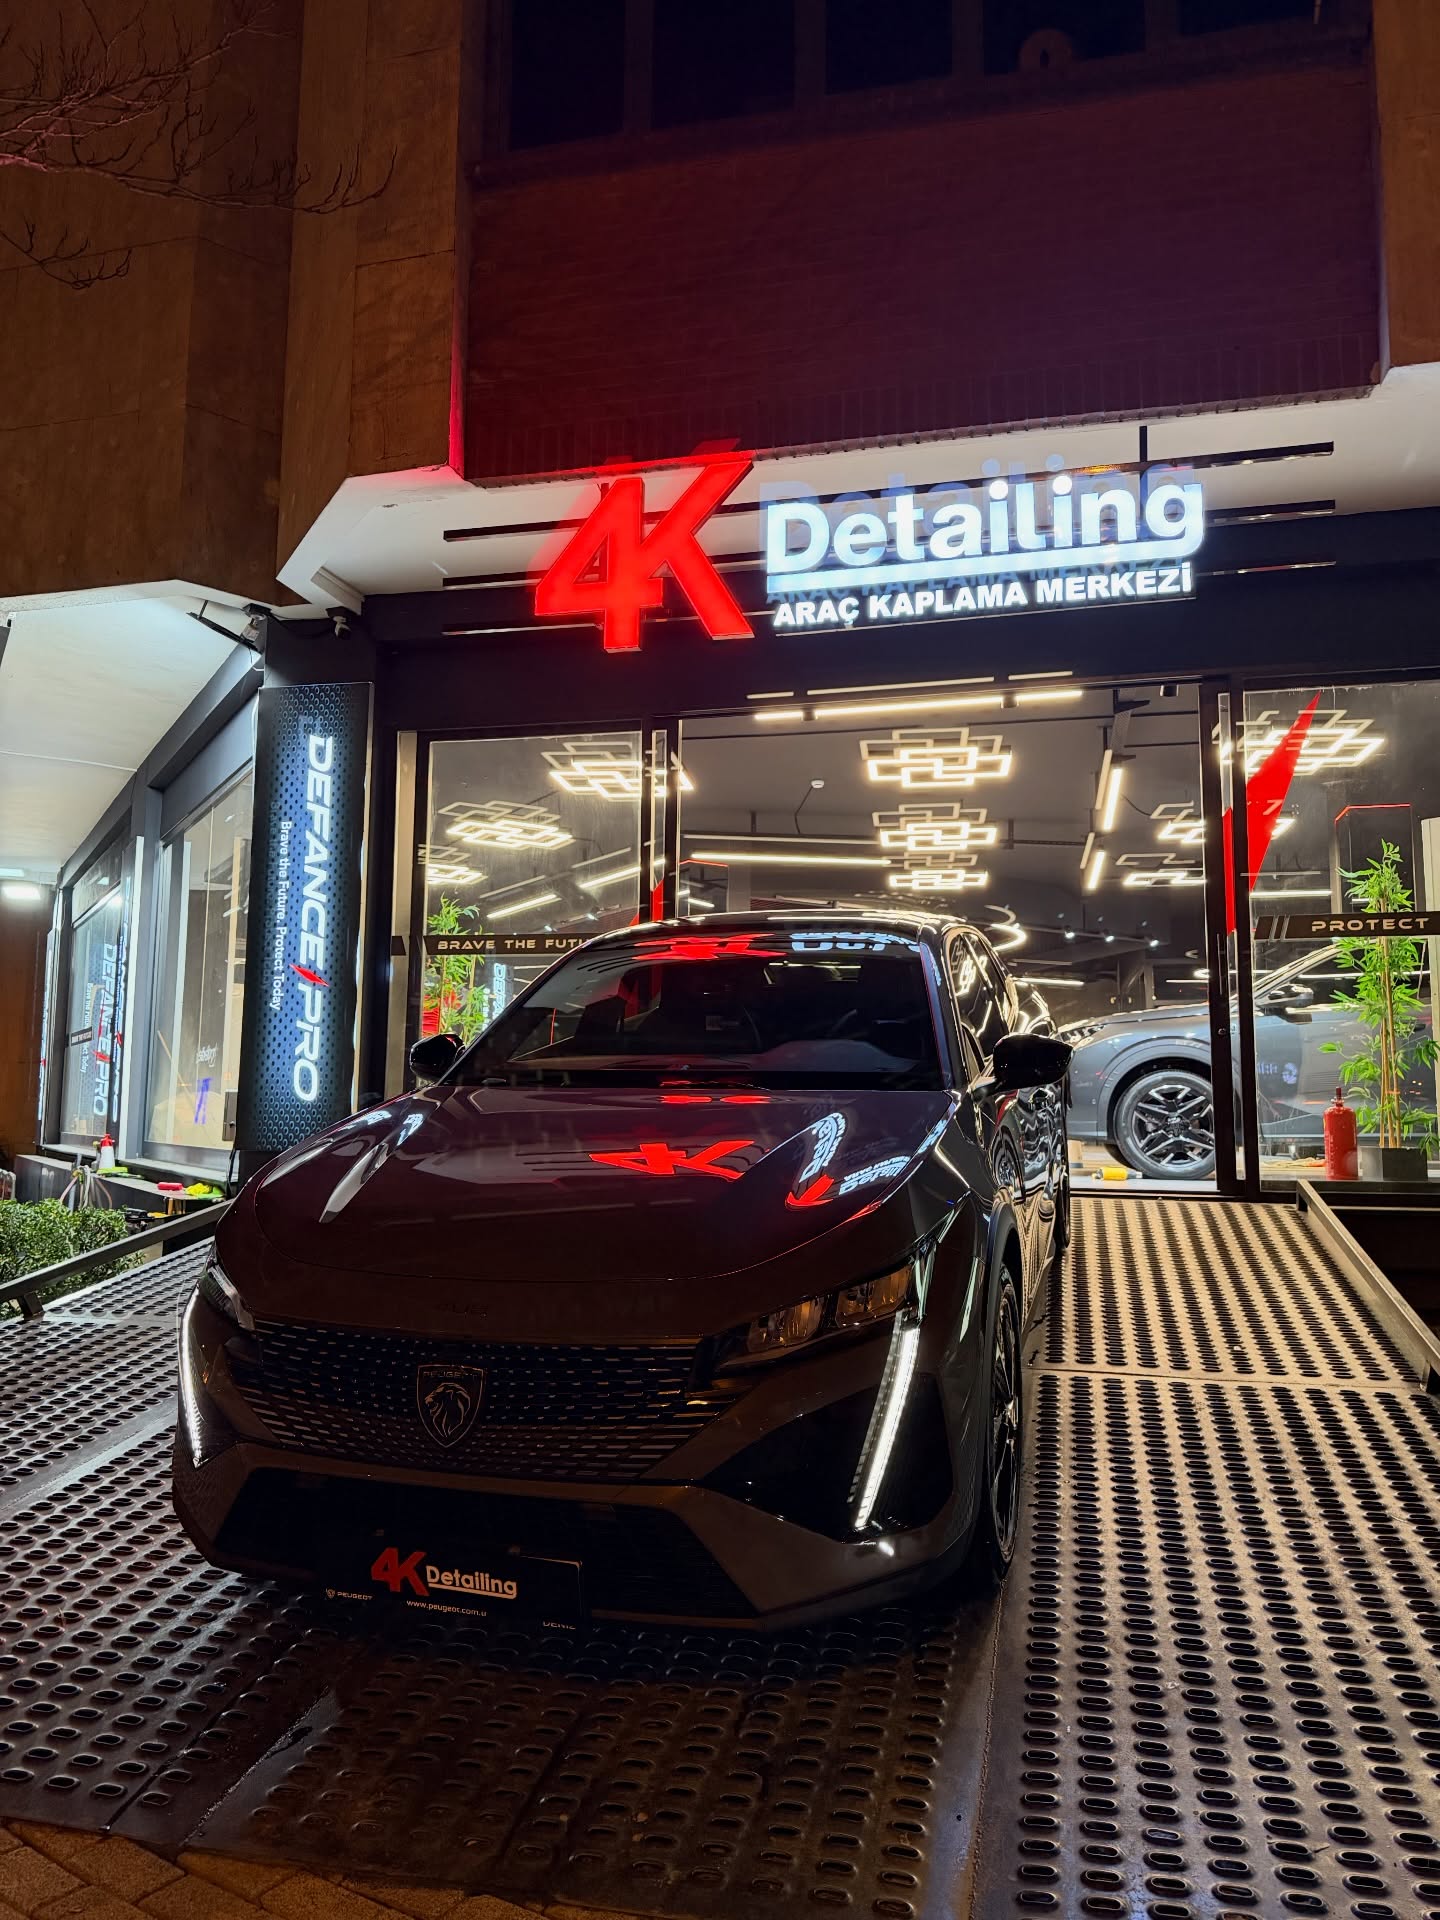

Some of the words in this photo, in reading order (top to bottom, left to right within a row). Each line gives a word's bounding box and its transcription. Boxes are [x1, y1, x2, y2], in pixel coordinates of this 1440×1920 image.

[535, 456, 755, 653] 4K
[766, 474, 1206, 577] Detailing
[773, 600, 862, 628] ARAÇ
[868, 580, 1028, 620] KAPLAMA
[1036, 561, 1193, 604] MERKEZİ
[279, 820, 292, 855] Brave
[300, 734, 333, 971] DEFANCE
[278, 855, 291, 878] the
[276, 879, 290, 924] Future.
[437, 940, 496, 950] BRAVE
[504, 939, 536, 949] THE
[1311, 918, 1430, 932] PROTECT
[274, 926, 288, 970] Protect
[270, 972, 285, 1011] Today
[294, 981, 322, 1102] PRO
[370, 1547, 430, 1597] 4K
[425, 1565, 517, 1600] Detailing
[336, 1591, 374, 1601] PEUGEOT
